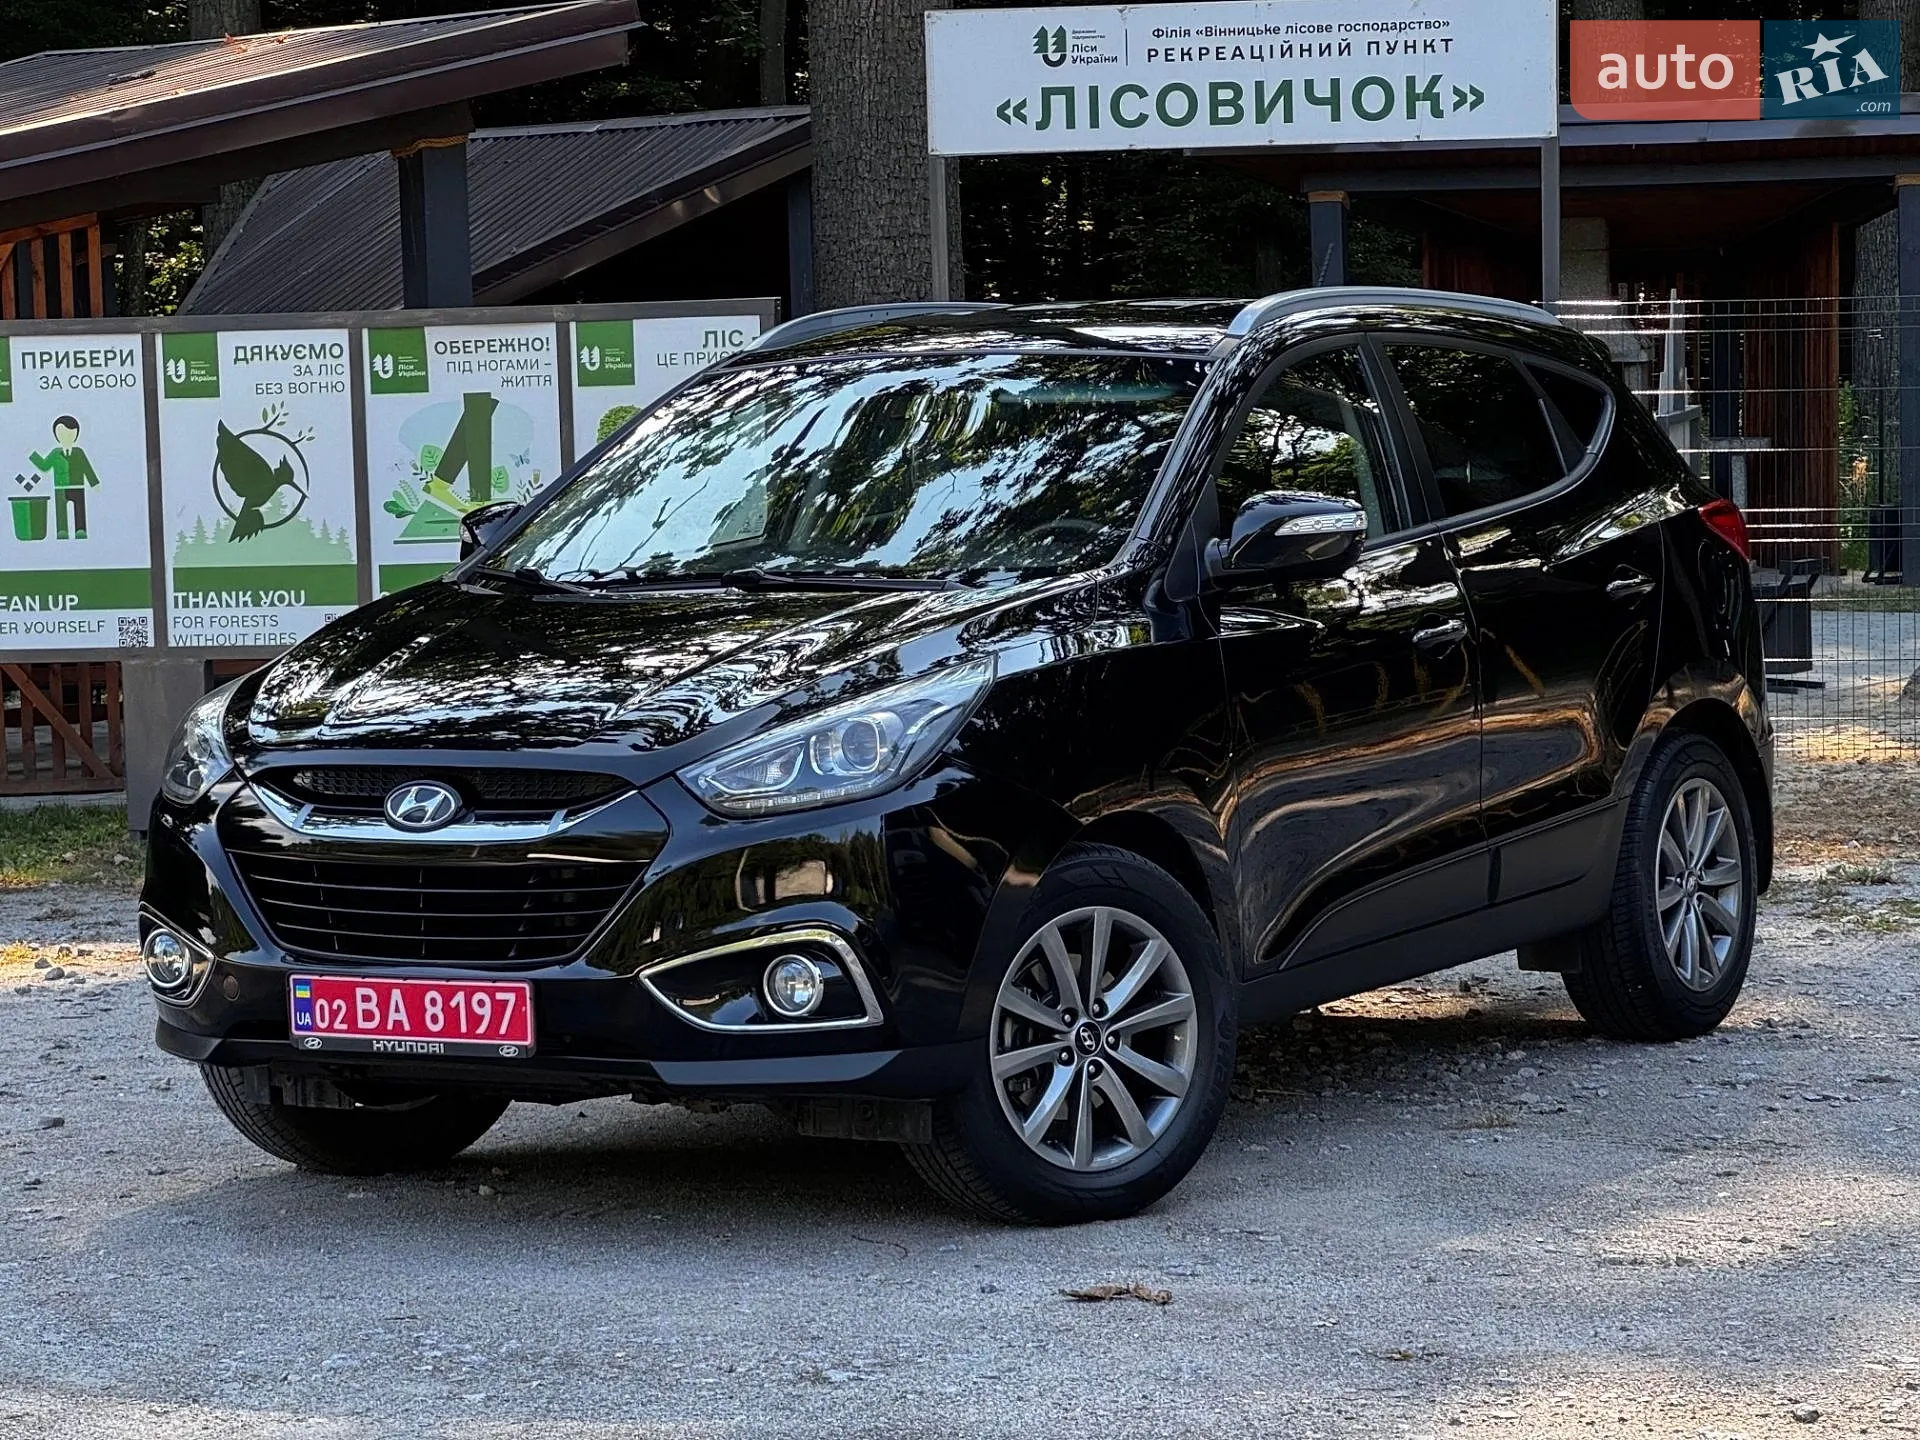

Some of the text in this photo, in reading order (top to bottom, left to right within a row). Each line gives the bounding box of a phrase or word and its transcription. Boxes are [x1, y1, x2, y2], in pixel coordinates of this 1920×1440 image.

[1152, 20, 1450, 38] Філія «Вінницьке лісове господарство»
[1071, 44, 1098, 53] Ліси
[1147, 38, 1453, 62] РЕКРЕАЦІЙНИЙ ПУНКТ
[1071, 54, 1118, 66] України
[996, 73, 1485, 131] «ЛІСОВИЧОК»
[434, 337, 550, 355] ОБЕРЕЖНО!
[703, 330, 744, 348] ЛІС
[21, 349, 134, 369] ПРИБЕРИ
[233, 343, 344, 365] ДЯКУЄМО
[657, 353, 679, 368] ЦЕ
[293, 363, 345, 376] ЗА ЛІС
[446, 360, 473, 374] ПІД
[477, 359, 539, 372] НОГАМИ
[39, 373, 136, 389] ЗА СОБОЮ
[255, 380, 345, 395] БЕЗ ВОГНЮ
[501, 375, 552, 388] ЖИТТЯ
[48, 594, 79, 611] UP
[173, 590, 306, 608] THANK YOU
[24, 620, 106, 634] YOURSELF
[173, 614, 279, 628] FOR FORESTS
[172, 632, 297, 646] WITHOUT FIRES
[296, 987, 516, 1035] UA 02 BA 8197
[373, 1040, 445, 1054] HYUNDAI
